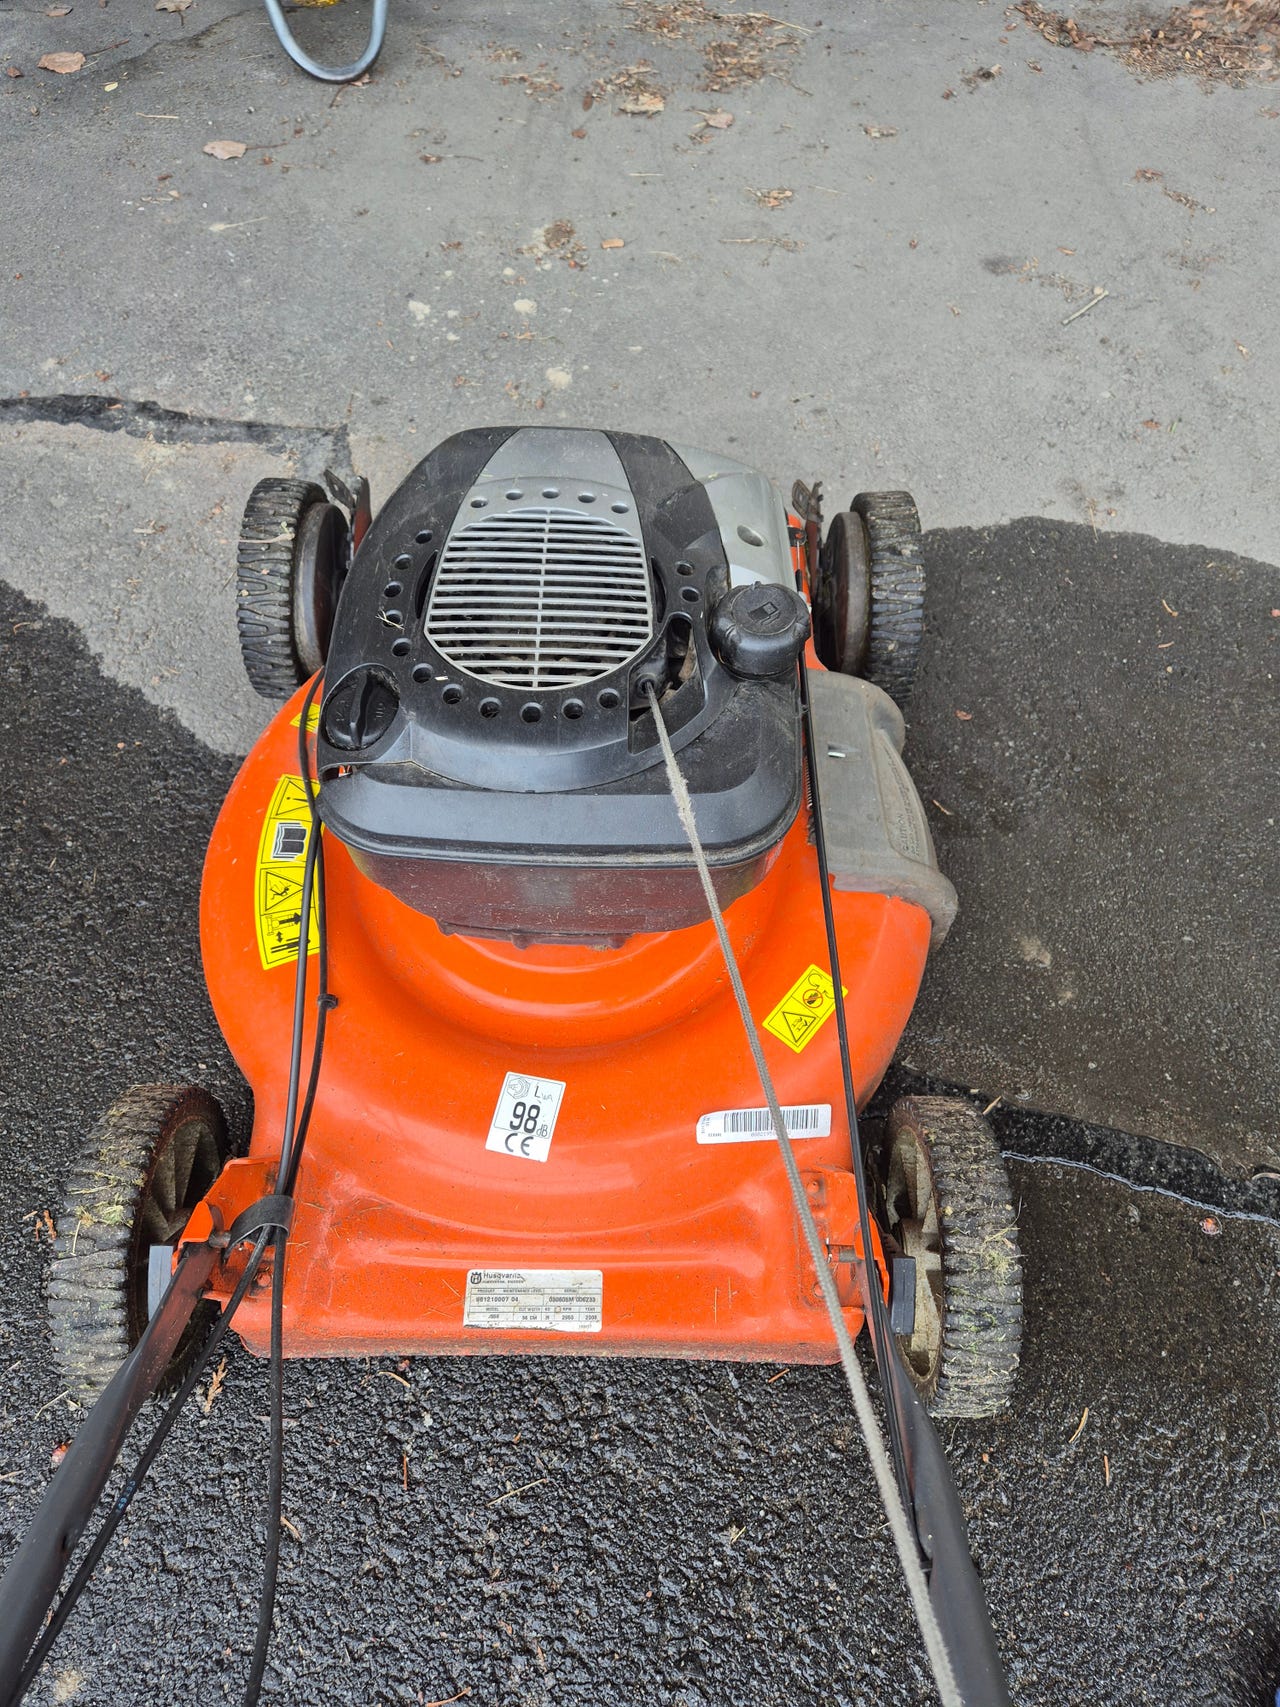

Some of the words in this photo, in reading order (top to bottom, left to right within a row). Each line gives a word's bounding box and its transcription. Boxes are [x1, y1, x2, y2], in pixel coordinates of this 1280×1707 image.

[510, 1101, 540, 1133] 98
[536, 1123, 549, 1138] dB
[505, 1133, 534, 1156] CE
